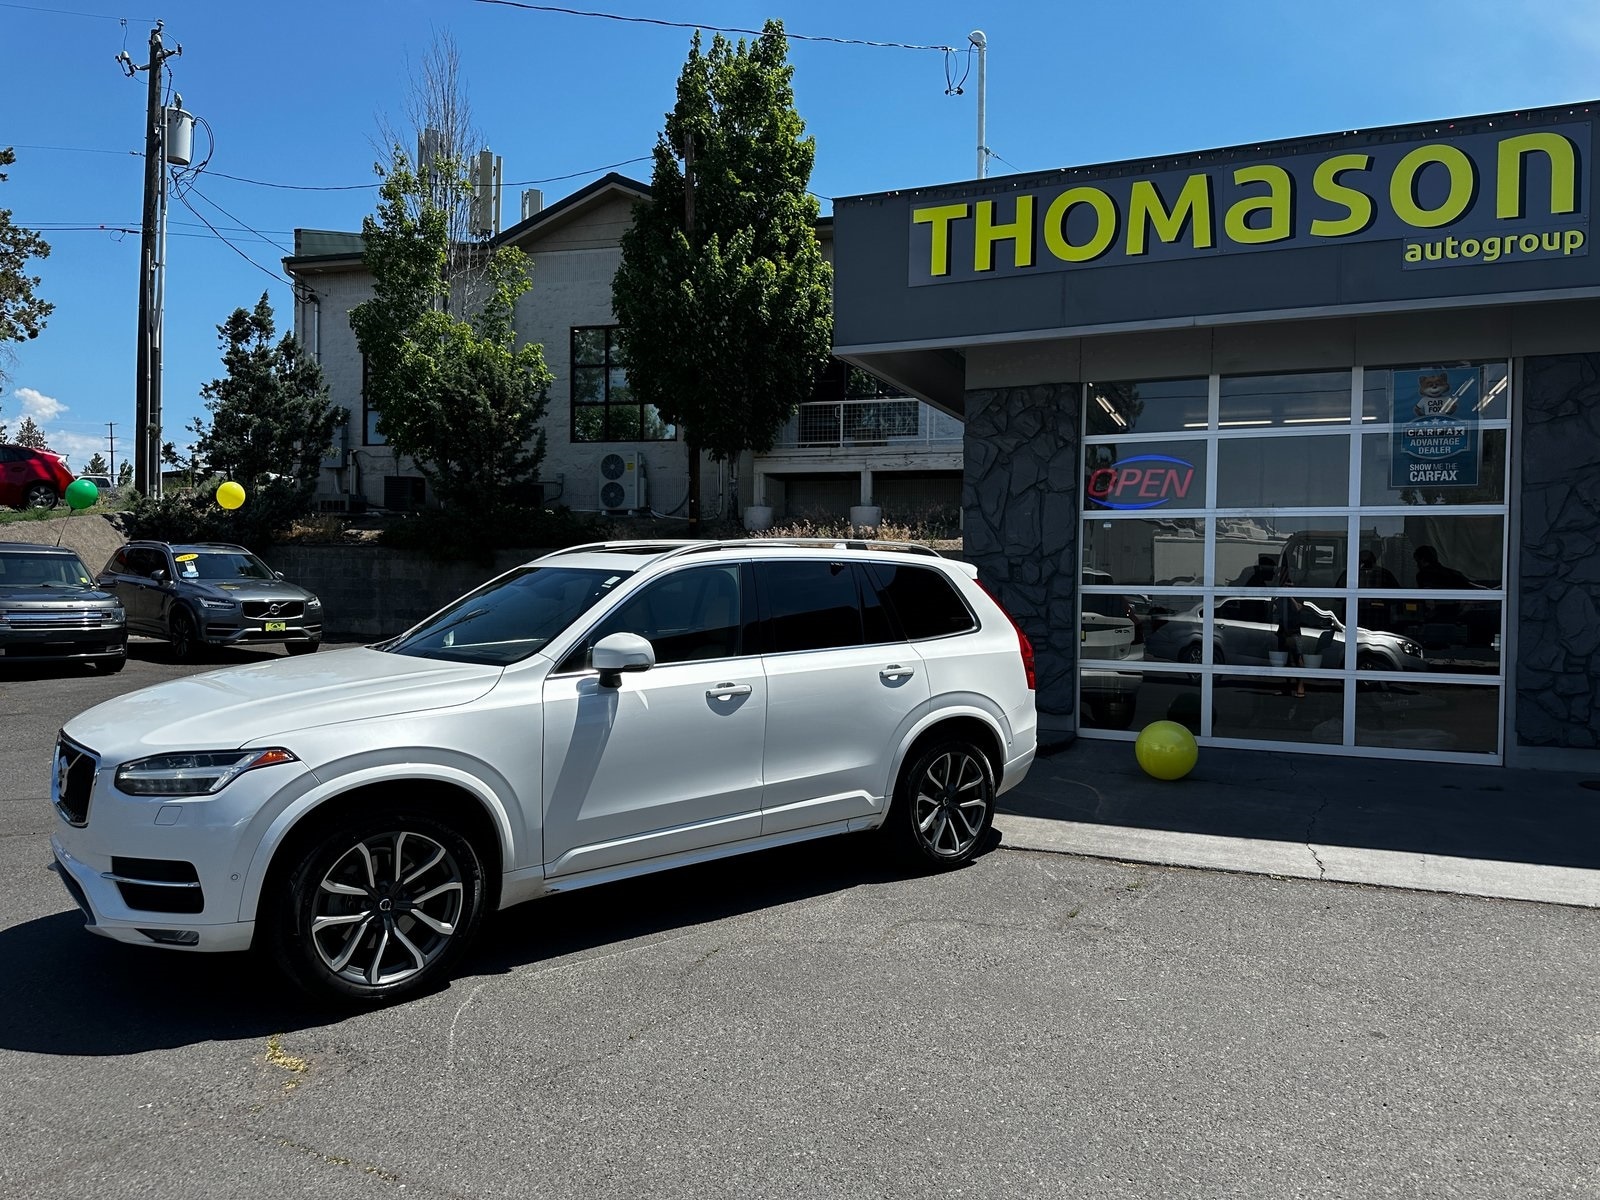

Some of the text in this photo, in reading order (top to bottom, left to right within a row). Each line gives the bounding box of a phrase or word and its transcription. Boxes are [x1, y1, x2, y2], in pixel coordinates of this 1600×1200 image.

[1404, 229, 1584, 262] autogroup
[1407, 428, 1464, 436] CARFAX
[1410, 438, 1460, 447] ADVANTAGE
[1445, 462, 1457, 470] THE
[1409, 470, 1457, 482] CARFAX
[1087, 468, 1194, 498] OPEN
